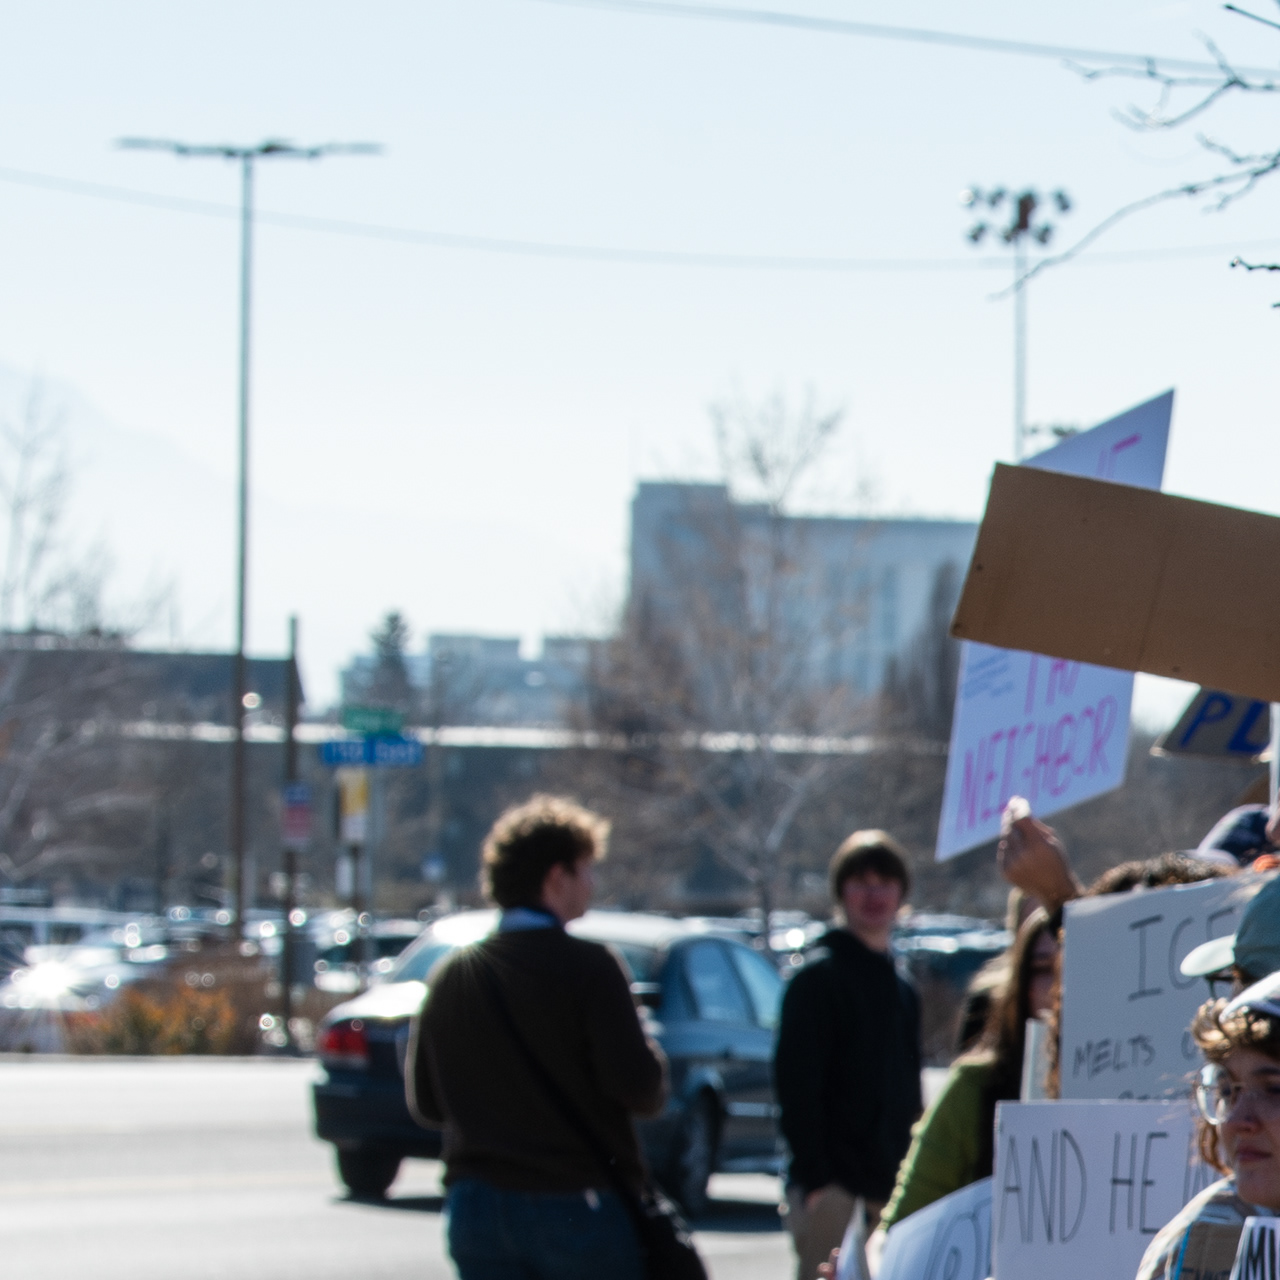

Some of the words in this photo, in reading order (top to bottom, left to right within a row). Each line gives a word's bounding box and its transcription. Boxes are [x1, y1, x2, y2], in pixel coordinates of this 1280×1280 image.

[1179, 691, 1270, 753] PL
[1072, 1033, 1156, 1081] MELTS
[999, 1129, 1087, 1243] AND
[1109, 1131, 1168, 1234] HE
